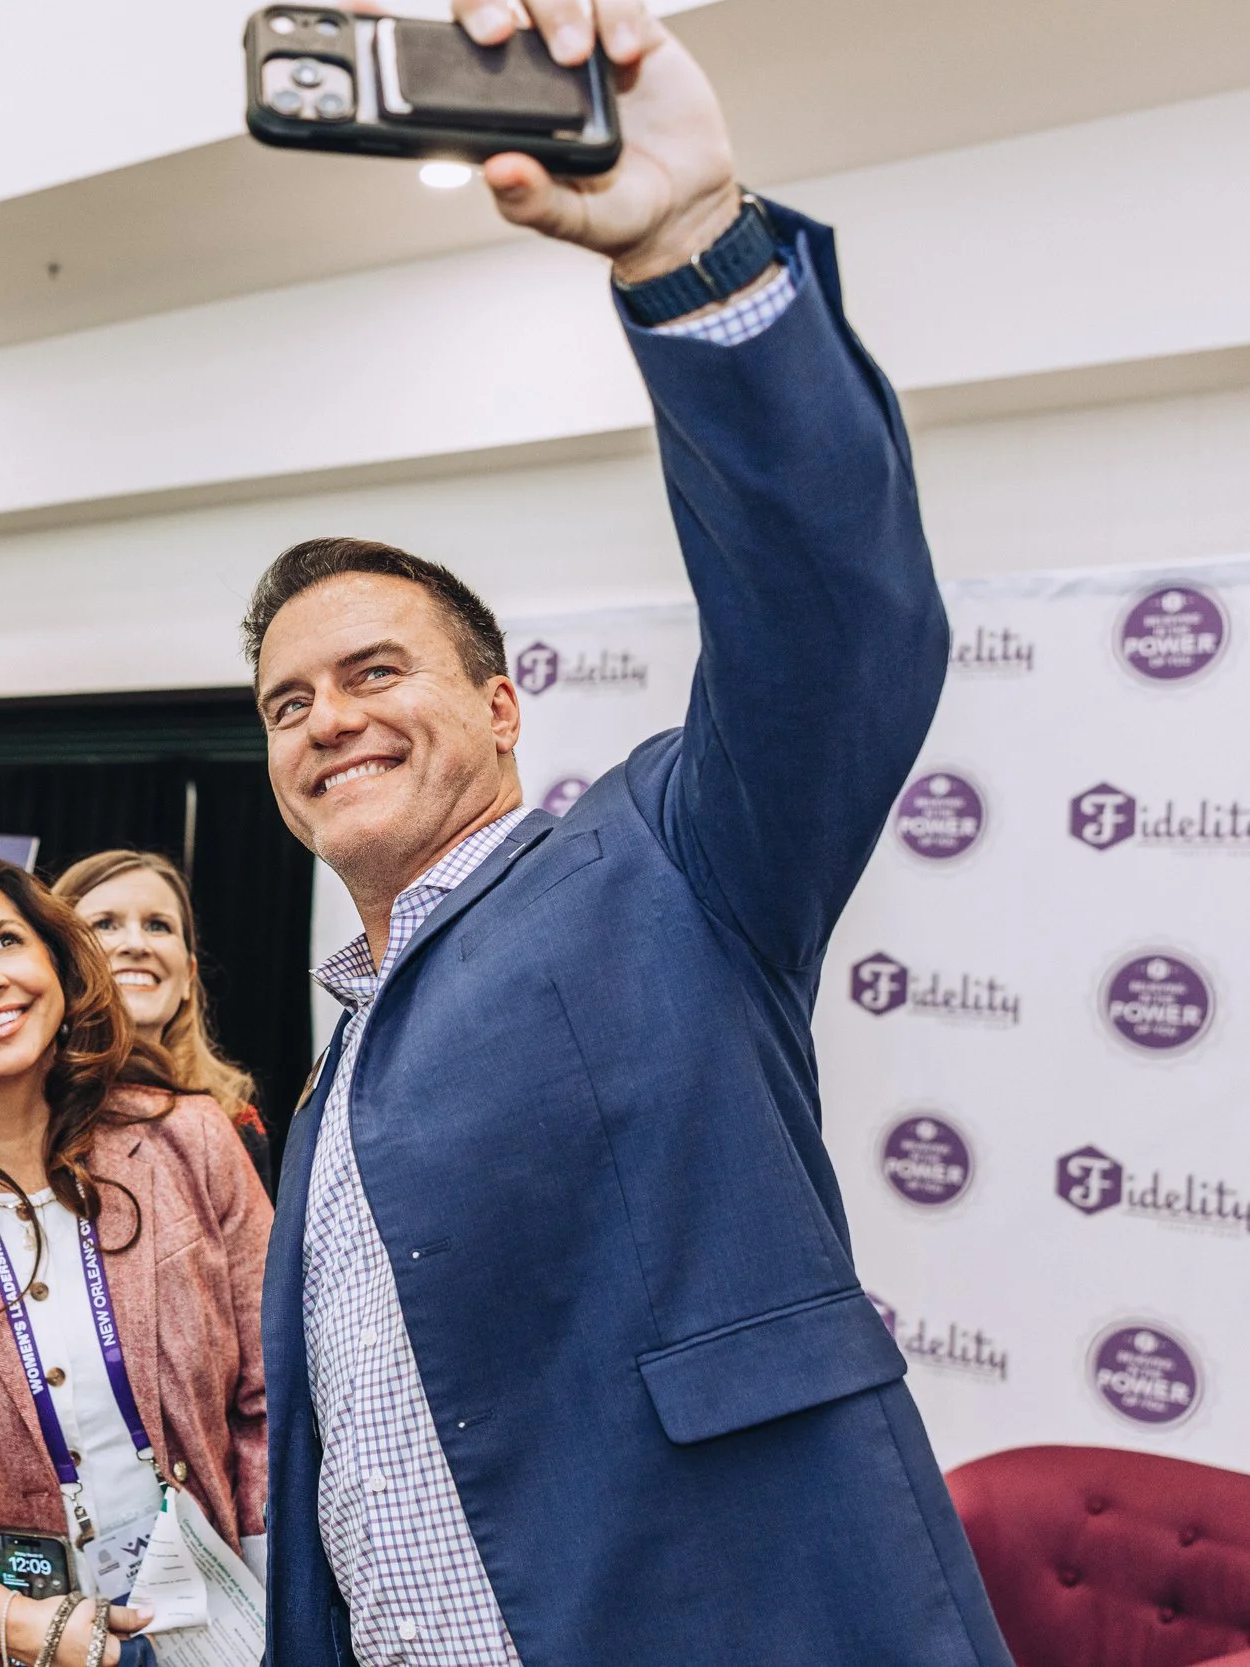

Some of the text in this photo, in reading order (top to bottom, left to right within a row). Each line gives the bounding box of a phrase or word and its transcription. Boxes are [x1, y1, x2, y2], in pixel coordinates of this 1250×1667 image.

[950, 626, 1035, 671] elity
[1124, 632, 1217, 658] POWER
[897, 816, 977, 837] POWER
[1079, 791, 1250, 845] Fidelit
[857, 960, 1020, 1025] Fidelity
[1109, 1000, 1201, 1027] POWER
[883, 1156, 964, 1186] POWER
[82, 1238, 107, 1308] ORLEANS
[95, 1310, 117, 1347] NEW
[13, 1320, 45, 1396] WOMEN'S
[1097, 1367, 1190, 1406] POWER
[8, 1556, 52, 1576] 12:09
